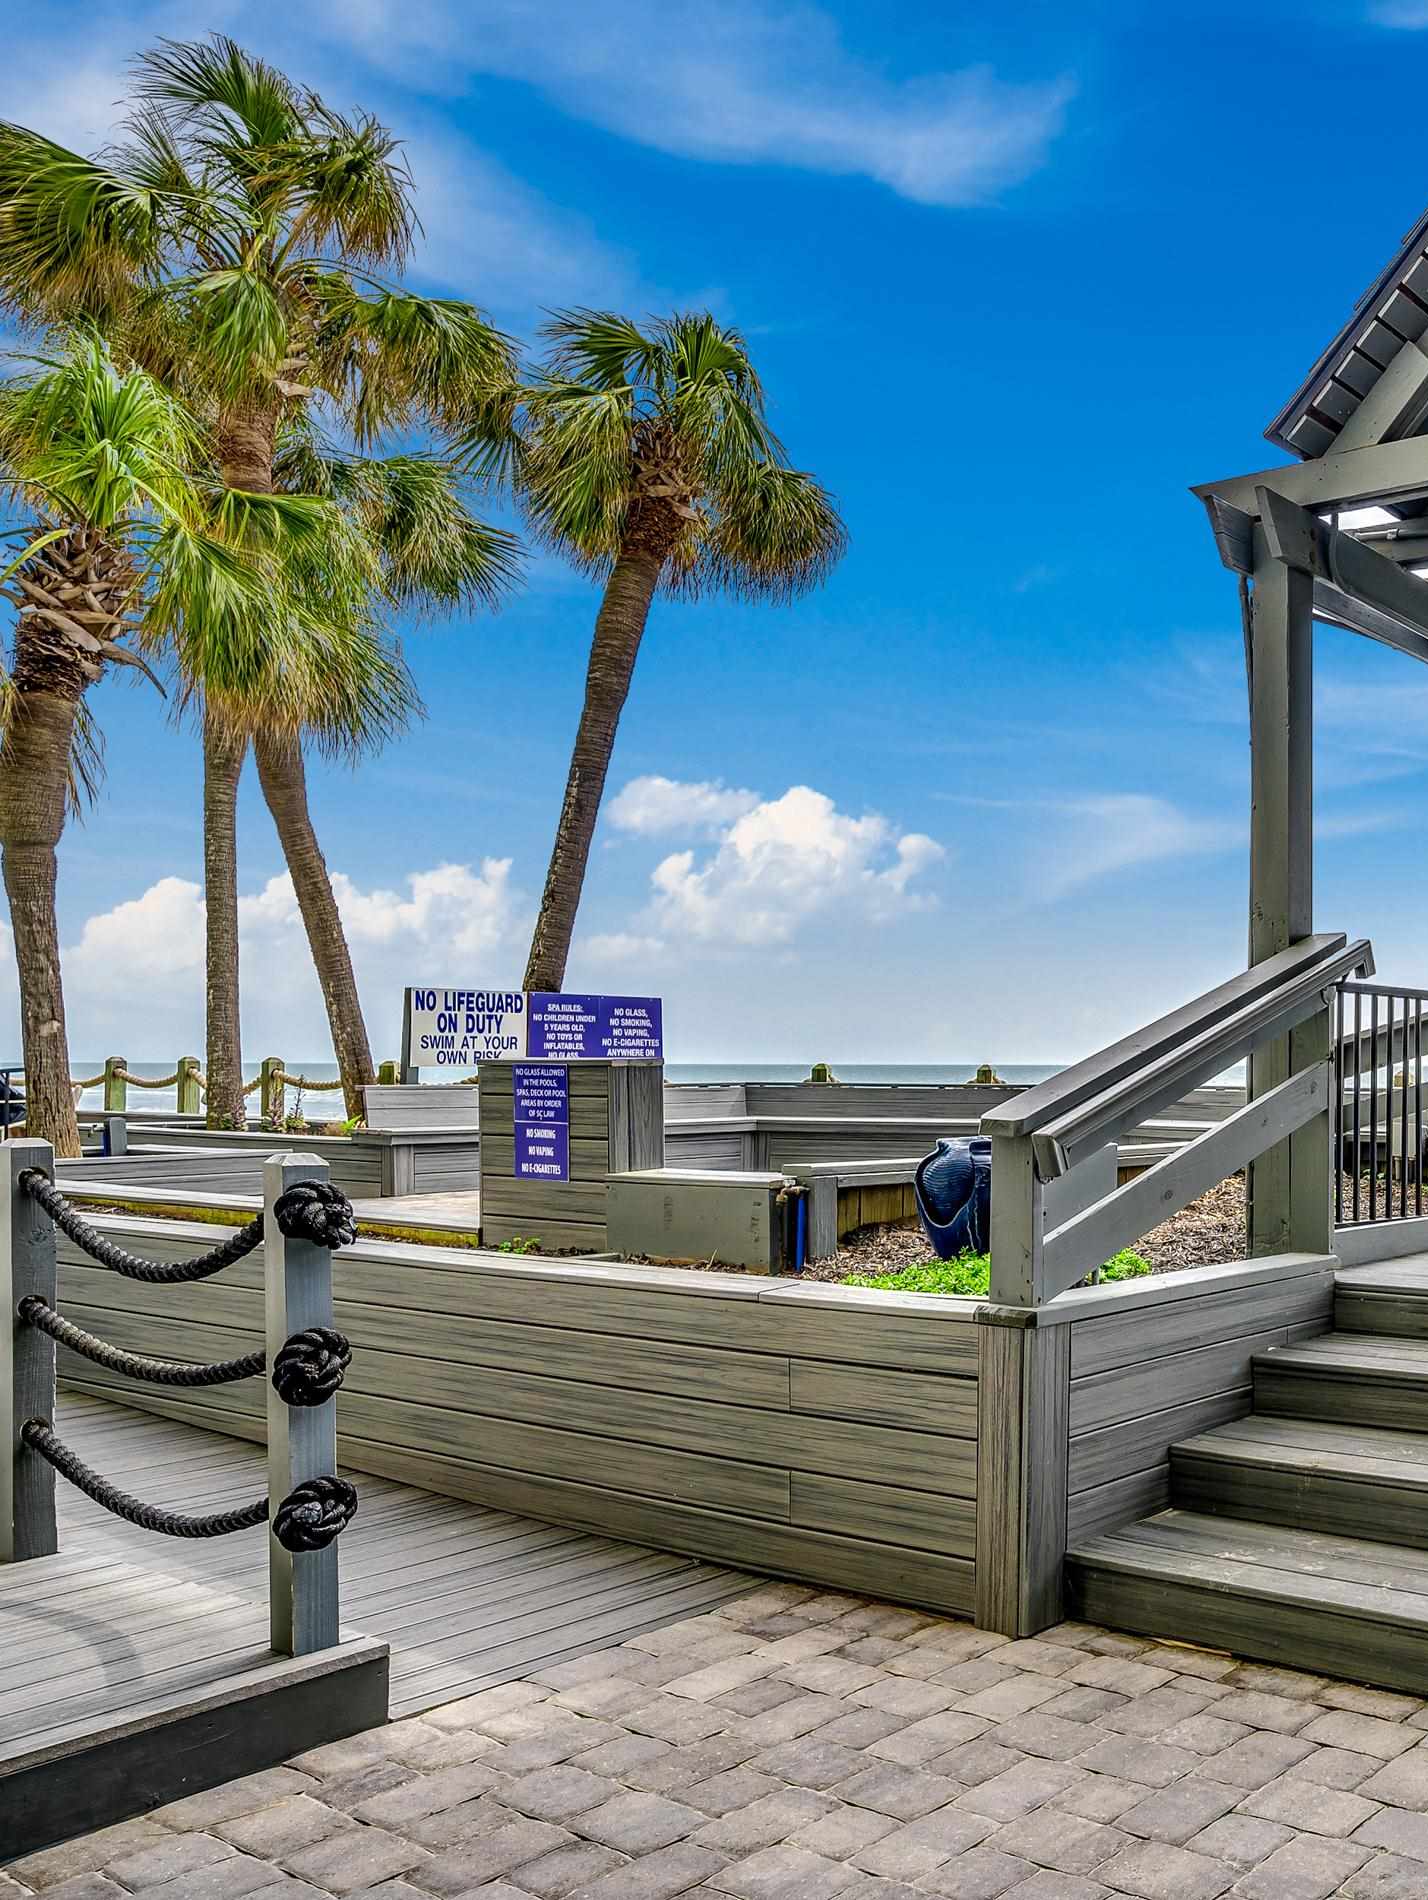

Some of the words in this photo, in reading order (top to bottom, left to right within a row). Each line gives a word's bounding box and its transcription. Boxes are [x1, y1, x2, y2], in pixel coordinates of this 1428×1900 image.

[415, 991, 436, 1011] NO
[444, 992, 523, 1013] LIFEGUARD
[614, 1008, 624, 1016] NO
[625, 1009, 648, 1018] GLASS,
[437, 1013, 457, 1033] ON
[466, 1014, 503, 1034] DUTY
[544, 1014, 574, 1022] CHILDREN
[576, 1015, 596, 1023] UNDER
[609, 1018, 619, 1027] NO
[621, 1018, 653, 1028] SMOKING,
[546, 1033, 556, 1041] NO
[557, 1033, 573, 1041] TOYS
[574, 1033, 583, 1041] OR
[612, 1028, 623, 1036] NO
[624, 1029, 650, 1038] VAPING,
[421, 1035, 454, 1049] SWIM
[461, 1036, 477, 1049] AT
[484, 1037, 517, 1050] YOUR
[544, 1042, 585, 1051] INFLATABLES,
[602, 1038, 612, 1047] NO
[613, 1038, 660, 1047] E-CIGARETTES
[606, 1048, 642, 1057] ANYWHERE
[645, 1049, 655, 1057] ON
[437, 1051, 467, 1065] OWN
[515, 1068, 523, 1076] NO
[524, 1068, 540, 1076] GLASS
[541, 1069, 565, 1077] ALLOWED
[530, 1089, 544, 1097] DECK
[521, 1099, 536, 1107] AREAS
[544, 1100, 562, 1108] ORDER
[543, 1110, 556, 1118] LAW
[526, 1128, 533, 1138] NO
[533, 1129, 556, 1139] SMOKING
[528, 1145, 535, 1156] NO
[536, 1145, 554, 1157] VAPING
[521, 1162, 529, 1173] NO
[529, 1163, 561, 1175] E-CIGARETTES
